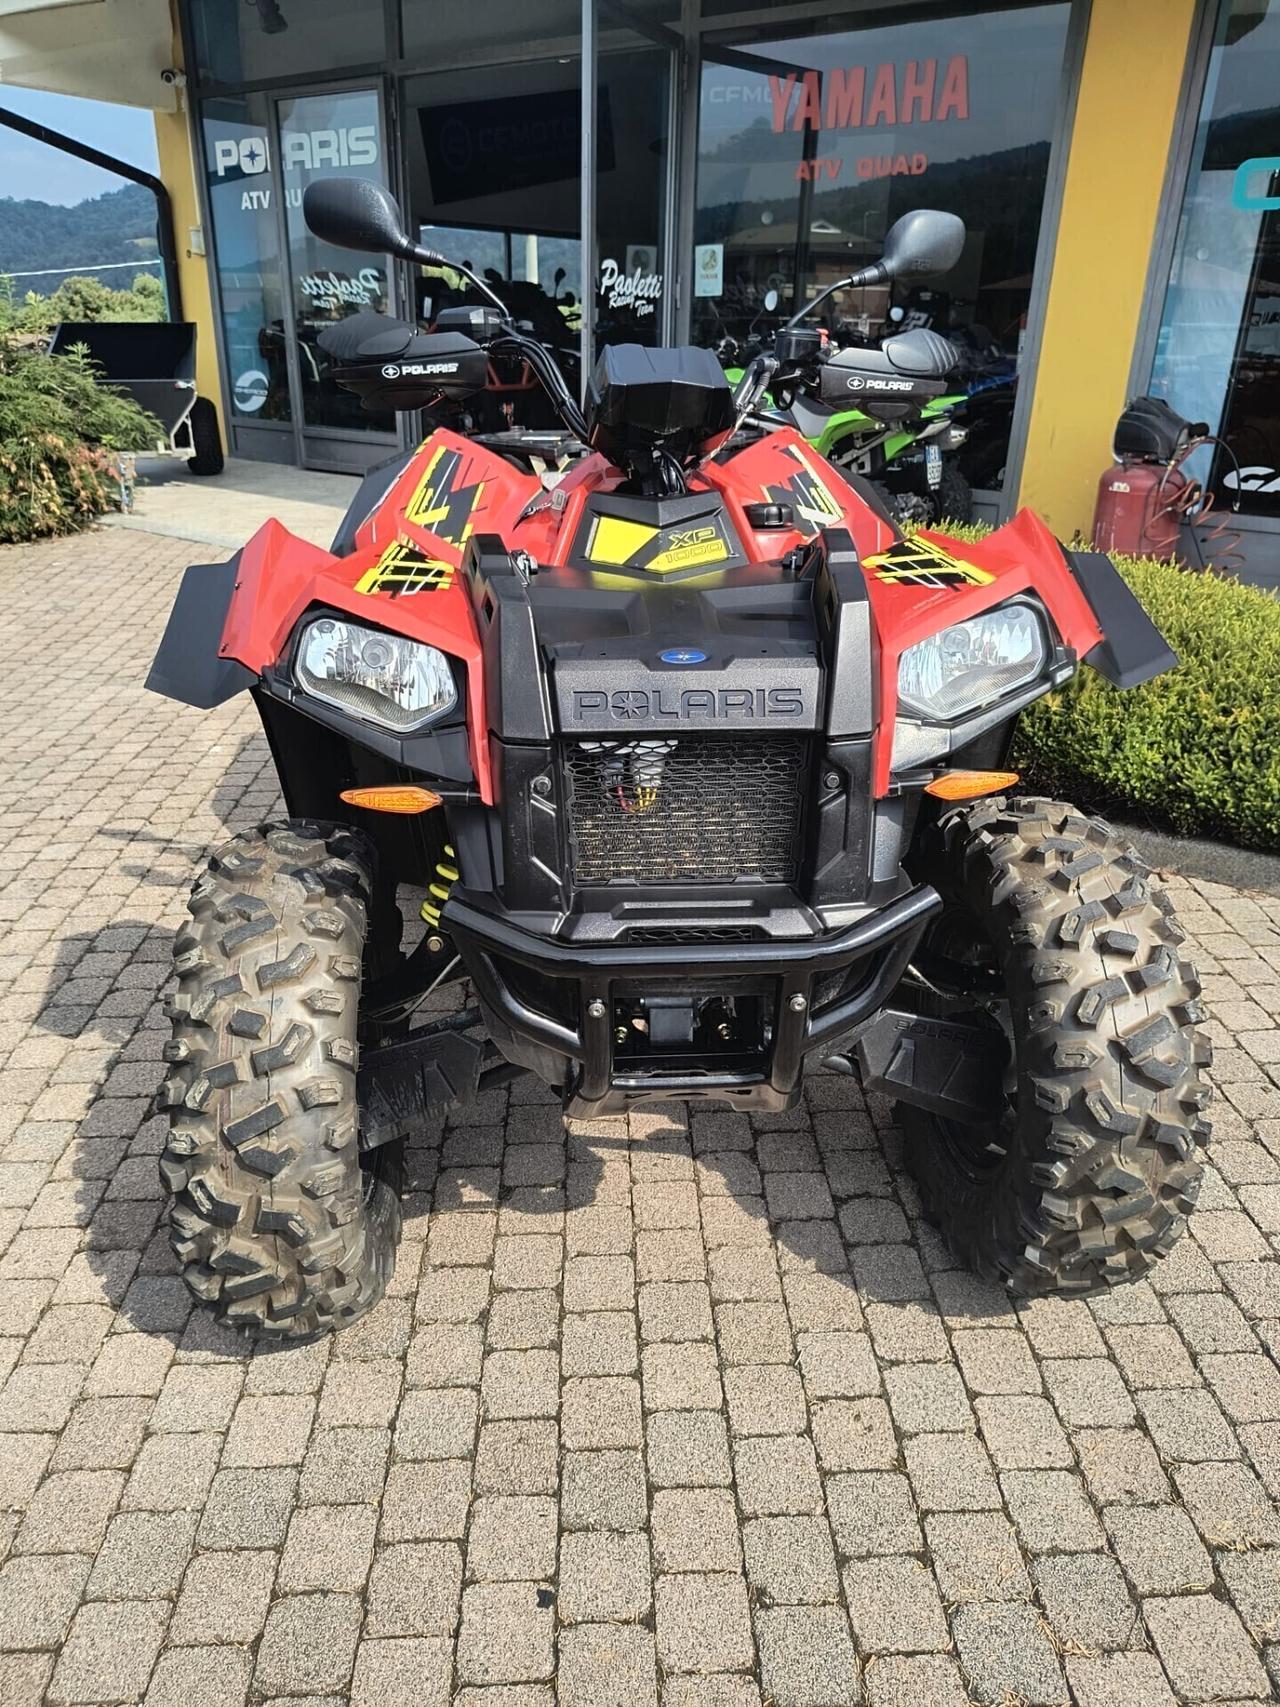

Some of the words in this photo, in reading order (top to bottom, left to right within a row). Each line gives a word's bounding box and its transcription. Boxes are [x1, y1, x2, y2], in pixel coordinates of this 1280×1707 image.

[768, 54, 970, 133] YAMAHA
[795, 159, 843, 181] ATV
[856, 154, 928, 178] QUAD
[241, 190, 271, 210] ATV
[601, 258, 662, 297] Paoletti
[608, 291, 635, 309] Racing
[634, 300, 654, 318] Team
[402, 363, 459, 375] POLARIS
[866, 379, 914, 391] POLARIS
[668, 526, 717, 549] XP
[665, 541, 723, 564] 1000
[572, 687, 804, 721] POLARIS
